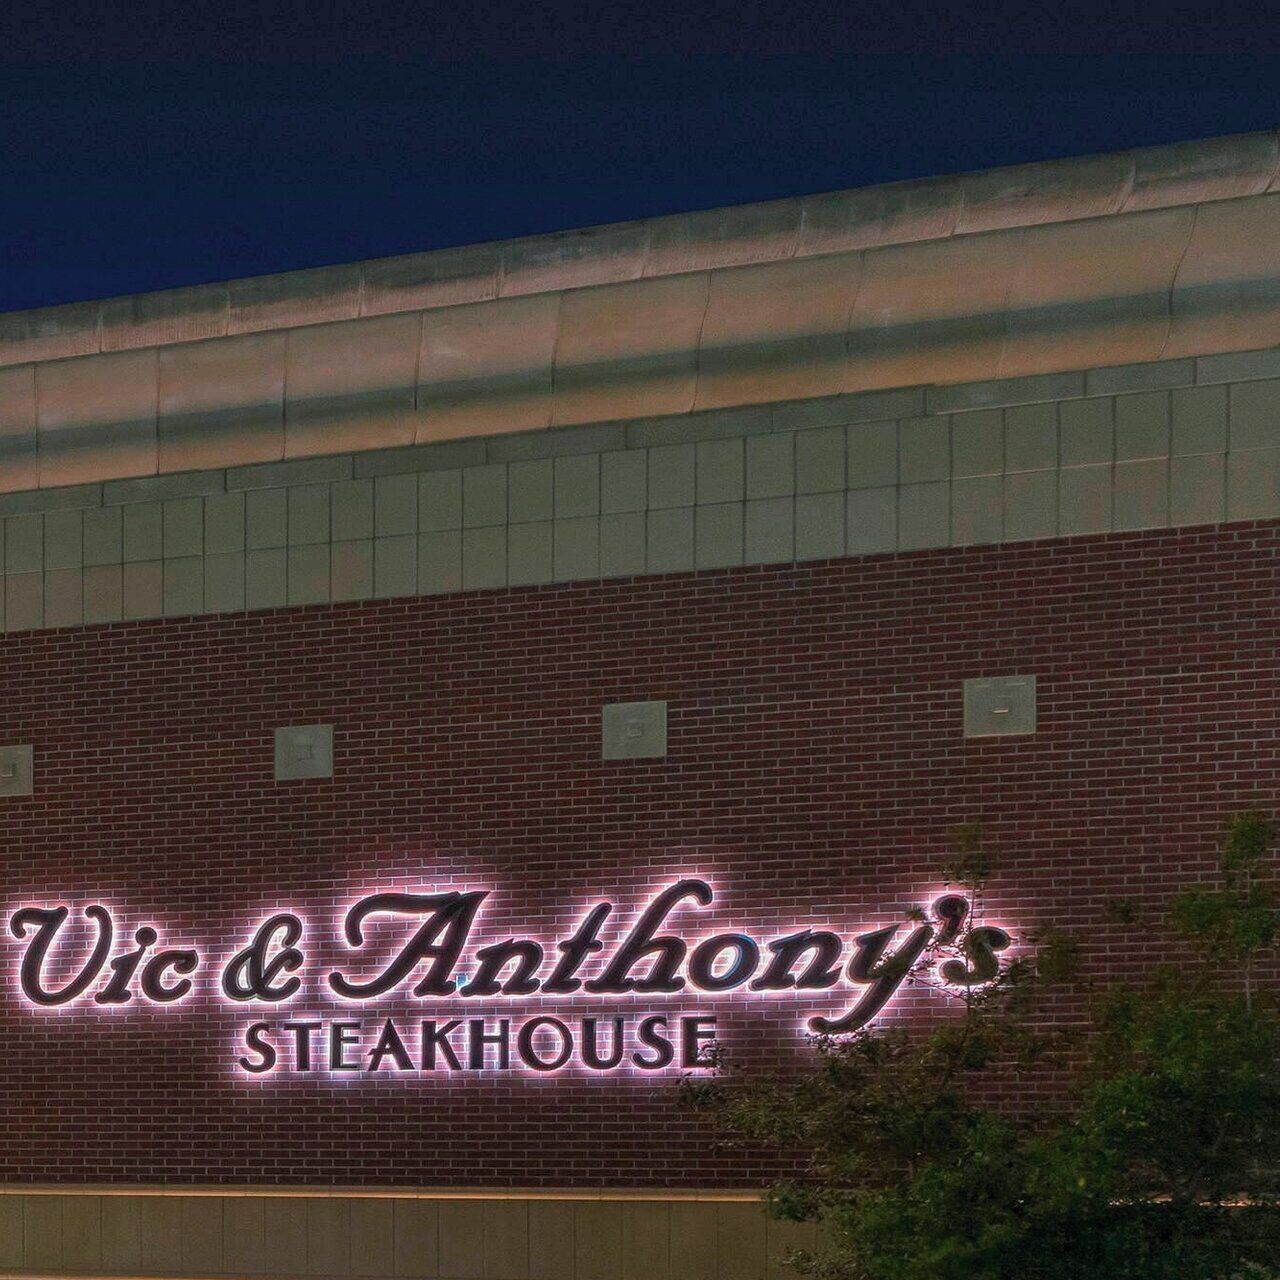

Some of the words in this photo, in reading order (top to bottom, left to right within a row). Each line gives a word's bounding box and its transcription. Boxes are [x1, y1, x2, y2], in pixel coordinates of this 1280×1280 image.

[10, 905, 198, 1006] Vic
[222, 914, 303, 1001] &
[328, 879, 1012, 1034] Anthony's
[239, 1014, 718, 1073] STEAKHOUSE
